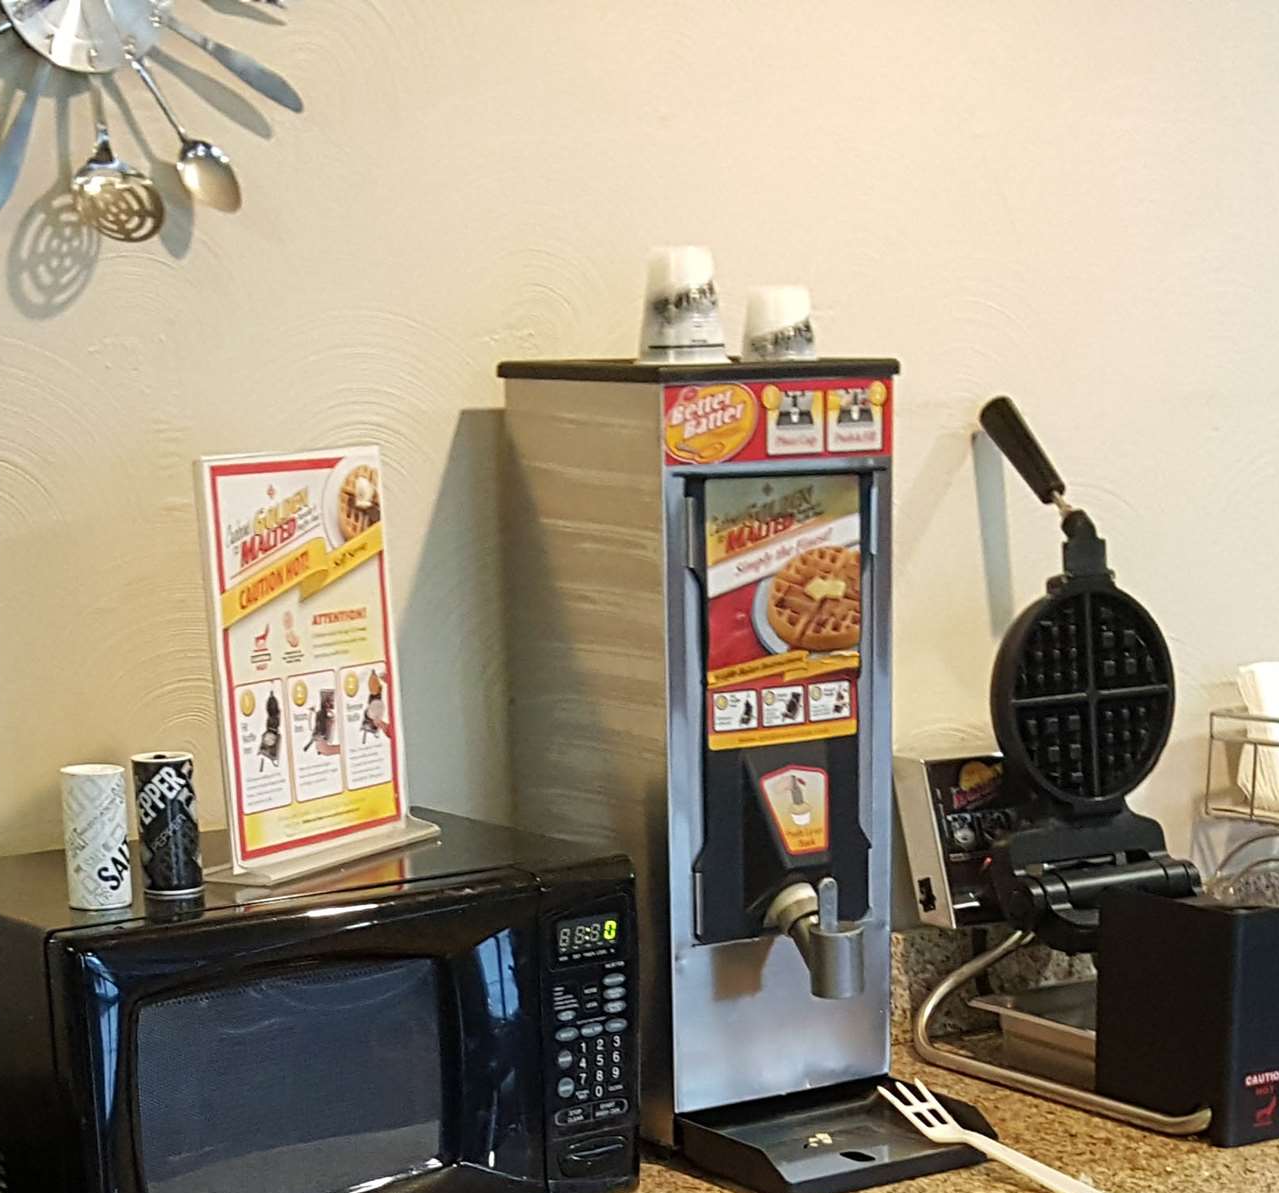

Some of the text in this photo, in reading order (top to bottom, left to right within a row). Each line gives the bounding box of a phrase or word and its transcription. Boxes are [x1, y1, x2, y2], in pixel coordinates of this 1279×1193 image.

[671, 390, 733, 426] Better
[683, 404, 744, 439] Batter
[239, 517, 297, 568] MALTED
[725, 512, 795, 554] MALTED
[239, 568, 284, 609] CAUTION
[138, 765, 187, 834] EPPER
[578, 1050, 621, 1069] 4 5 6
[580, 1035, 621, 1053] 1 2 3
[578, 1066, 620, 1085] 7 8 9
[595, 1085, 603, 1098] 0
